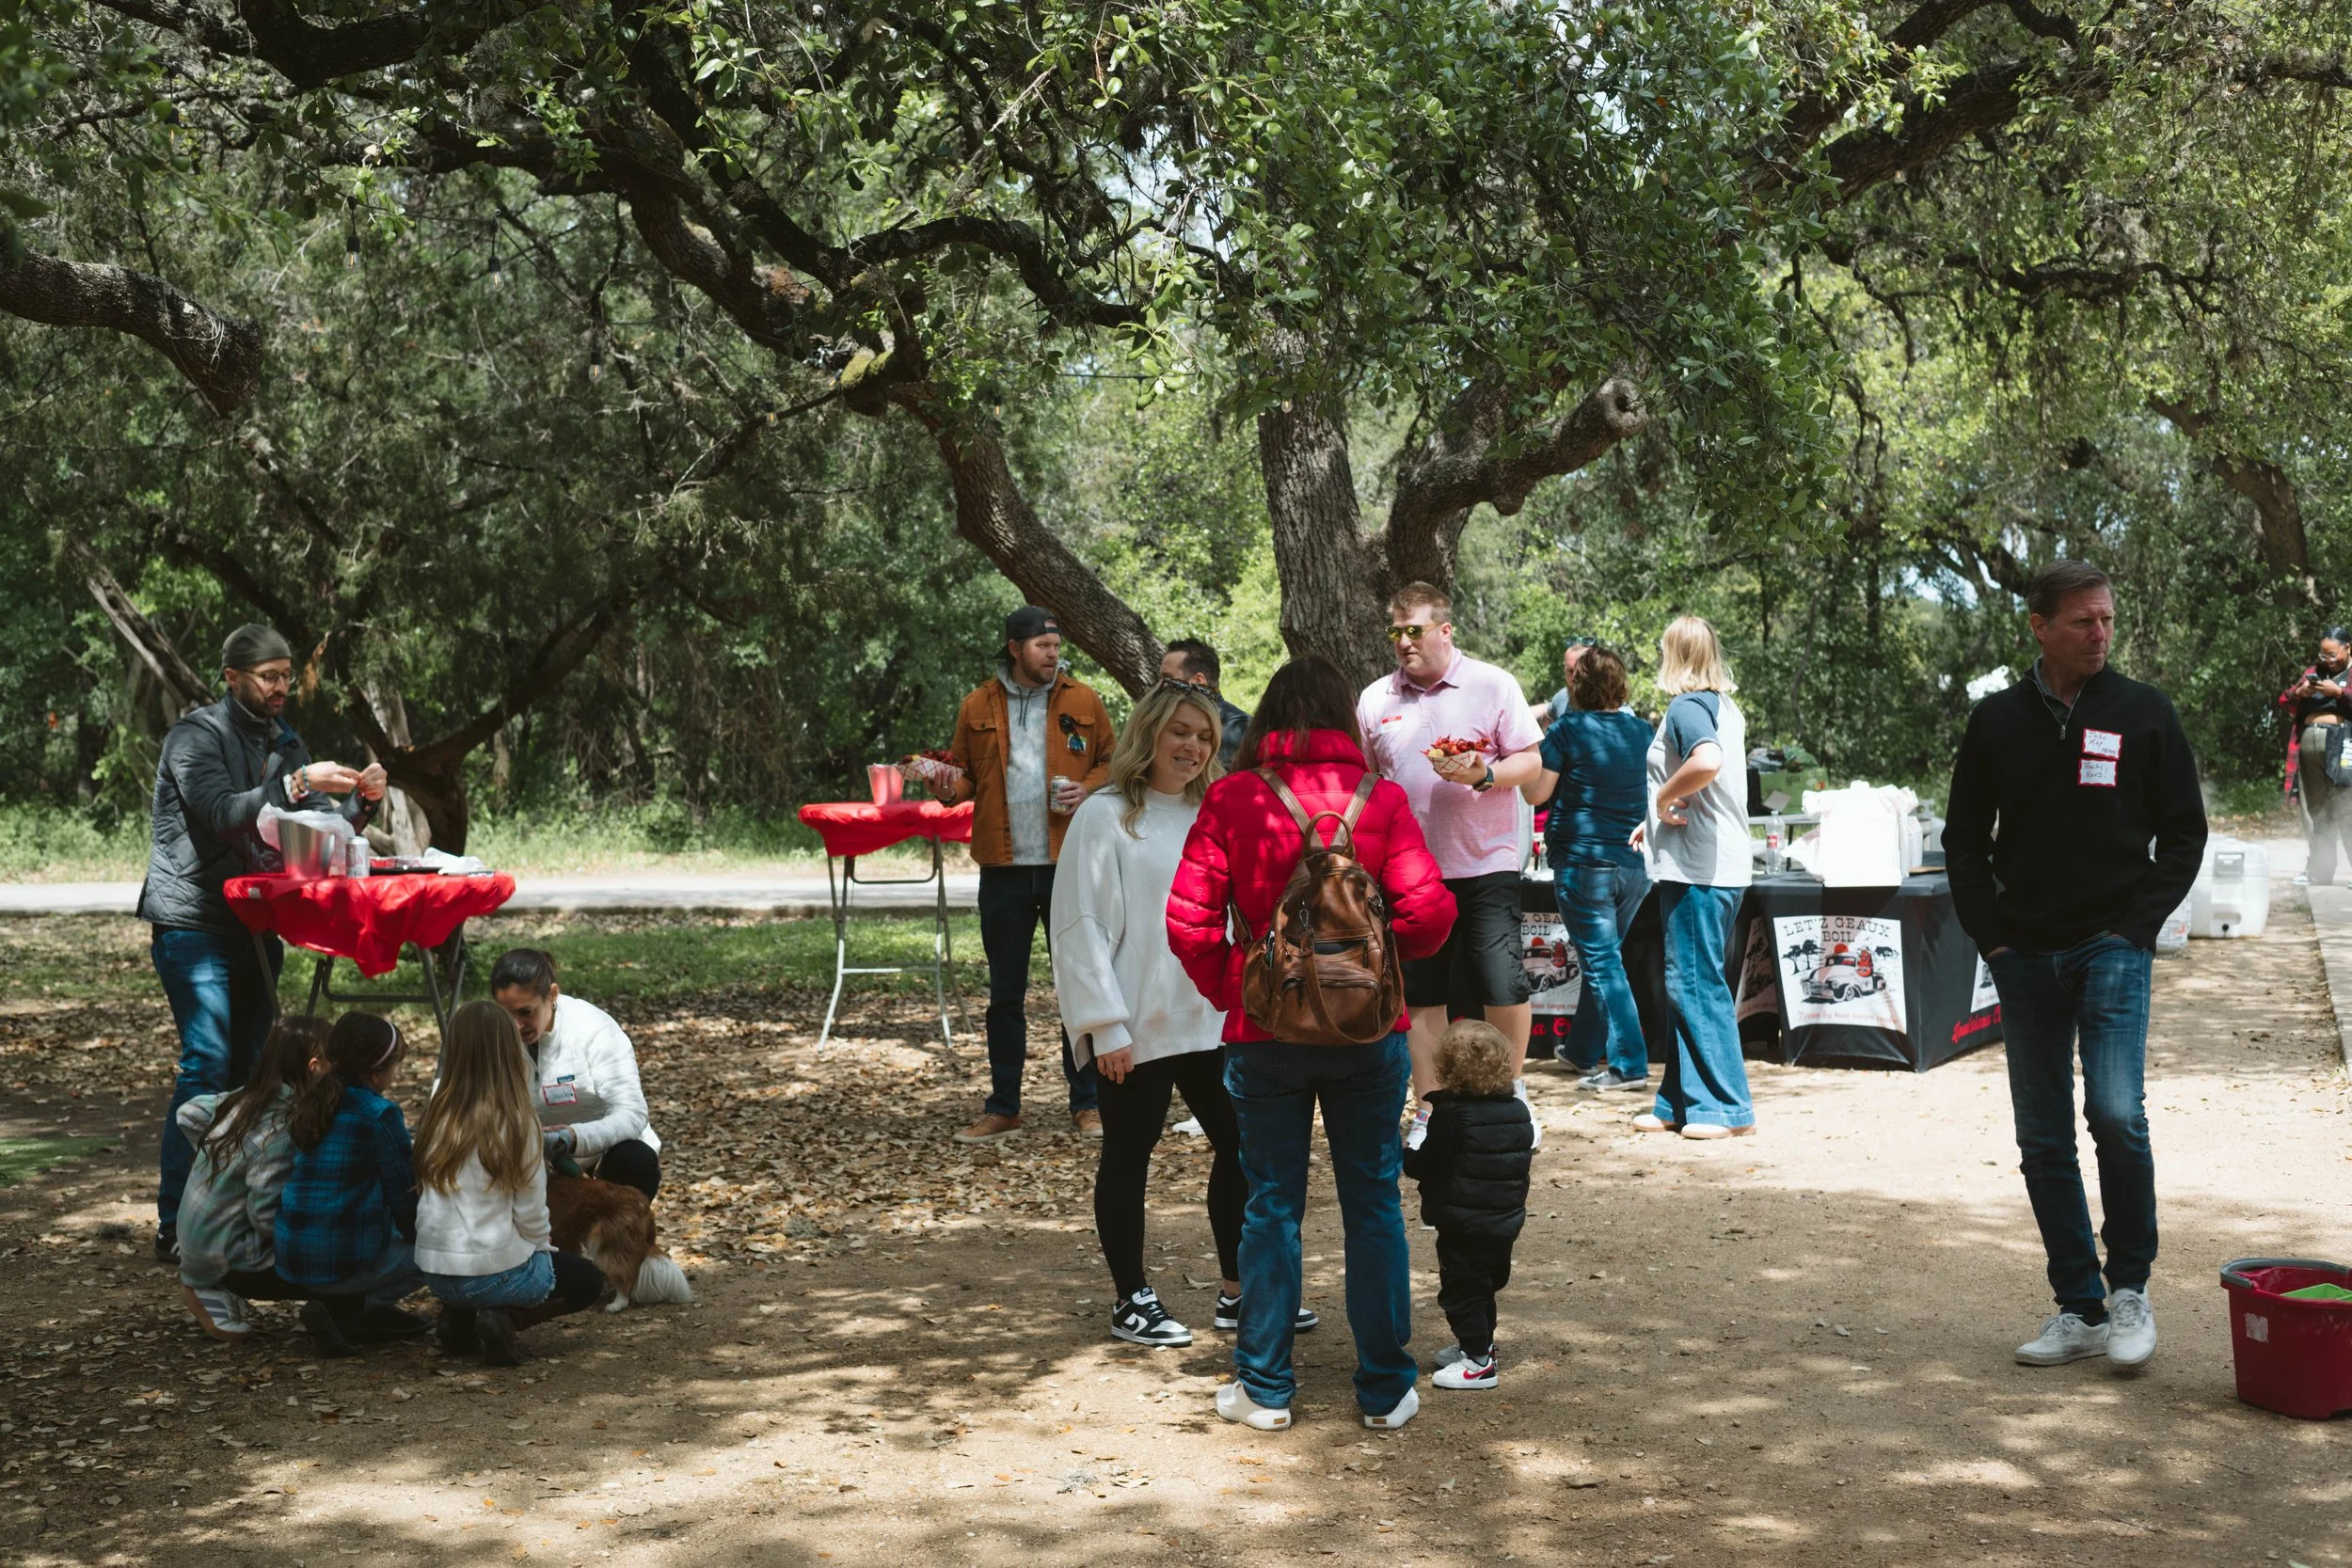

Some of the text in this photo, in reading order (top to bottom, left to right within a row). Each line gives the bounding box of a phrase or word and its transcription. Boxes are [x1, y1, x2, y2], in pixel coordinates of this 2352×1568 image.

[1533, 913, 1562, 924] GEA
[1521, 925, 1550, 936] BOIL
[1783, 917, 1828, 937] LET'Z
[1835, 917, 1891, 938] GEAUX
[1821, 930, 1855, 942] BOIL
